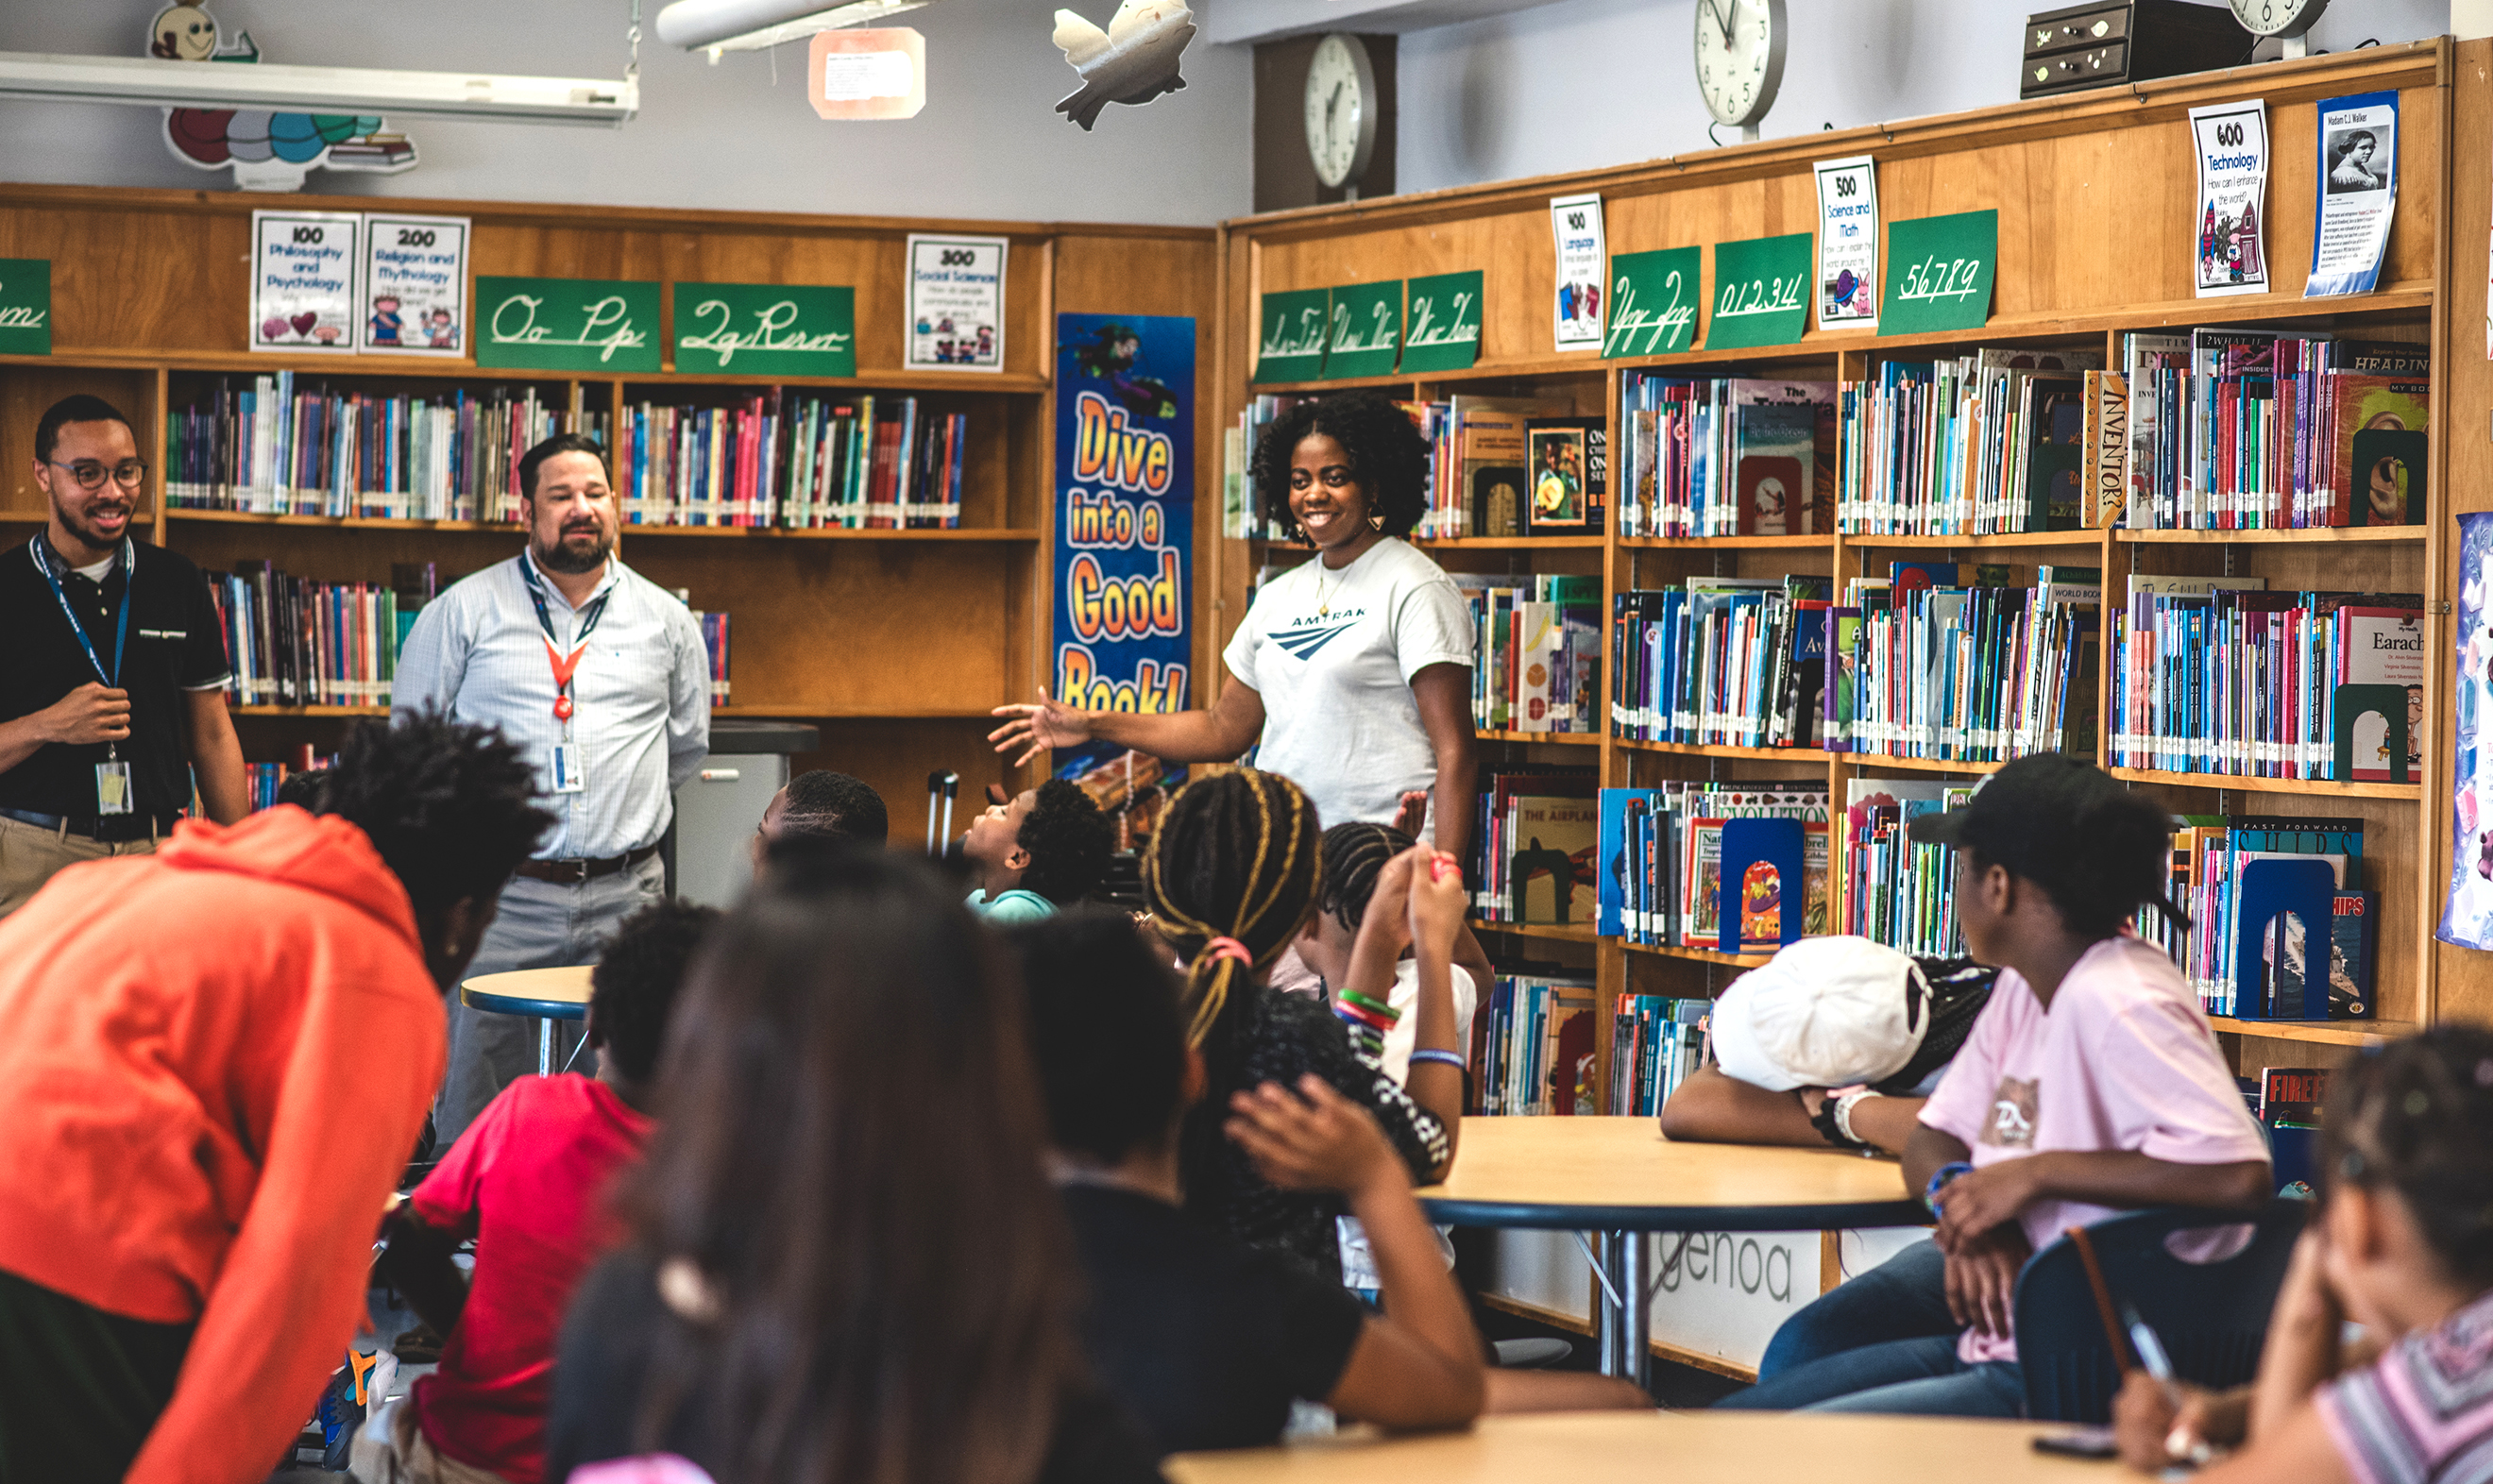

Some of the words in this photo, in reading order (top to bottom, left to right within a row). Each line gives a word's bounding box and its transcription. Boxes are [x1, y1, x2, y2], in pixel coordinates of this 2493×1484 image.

[1743, 82, 1750, 102] 5
[1727, 94, 1735, 114] 6
[2328, 115, 2344, 126] Madam
[2352, 113, 2367, 123] Walker
[2216, 122, 2244, 147] 600
[2208, 151, 2258, 171] Technology
[1836, 176, 1857, 197] 500
[2208, 178, 2221, 189] How
[2222, 178, 2232, 188] can
[2236, 175, 2258, 187] enhance
[2219, 194, 2228, 205] the
[1827, 203, 1854, 218] Science
[1856, 201, 1870, 215] and
[1568, 211, 1586, 230] 400
[293, 227, 324, 245] 100
[398, 228, 436, 247] 200
[1840, 223, 1858, 238] Math
[269, 244, 343, 261] Philosophy
[1564, 237, 1595, 252] Language
[376, 249, 425, 266] Religion
[428, 252, 455, 265] and
[941, 249, 975, 266] 300
[293, 261, 320, 274] and
[379, 266, 449, 284] Mythology
[266, 275, 344, 292] Psychology
[492, 295, 552, 344] Oo
[579, 296, 646, 363] Pp
[1785, 387, 1806, 397] The
[2391, 384, 2405, 393] MY
[1077, 391, 1174, 497] Dive
[2101, 389, 2127, 509] INVENTOR?
[1067, 487, 1137, 549] into
[1139, 500, 1164, 551] a
[1067, 546, 1183, 645] Good
[2055, 589, 2081, 598] WORLD
[2373, 632, 2424, 650] Earach
[1058, 642, 1187, 713] Book!
[1951, 794, 1966, 805] DK
[1659, 1231, 1791, 1303] genoa
